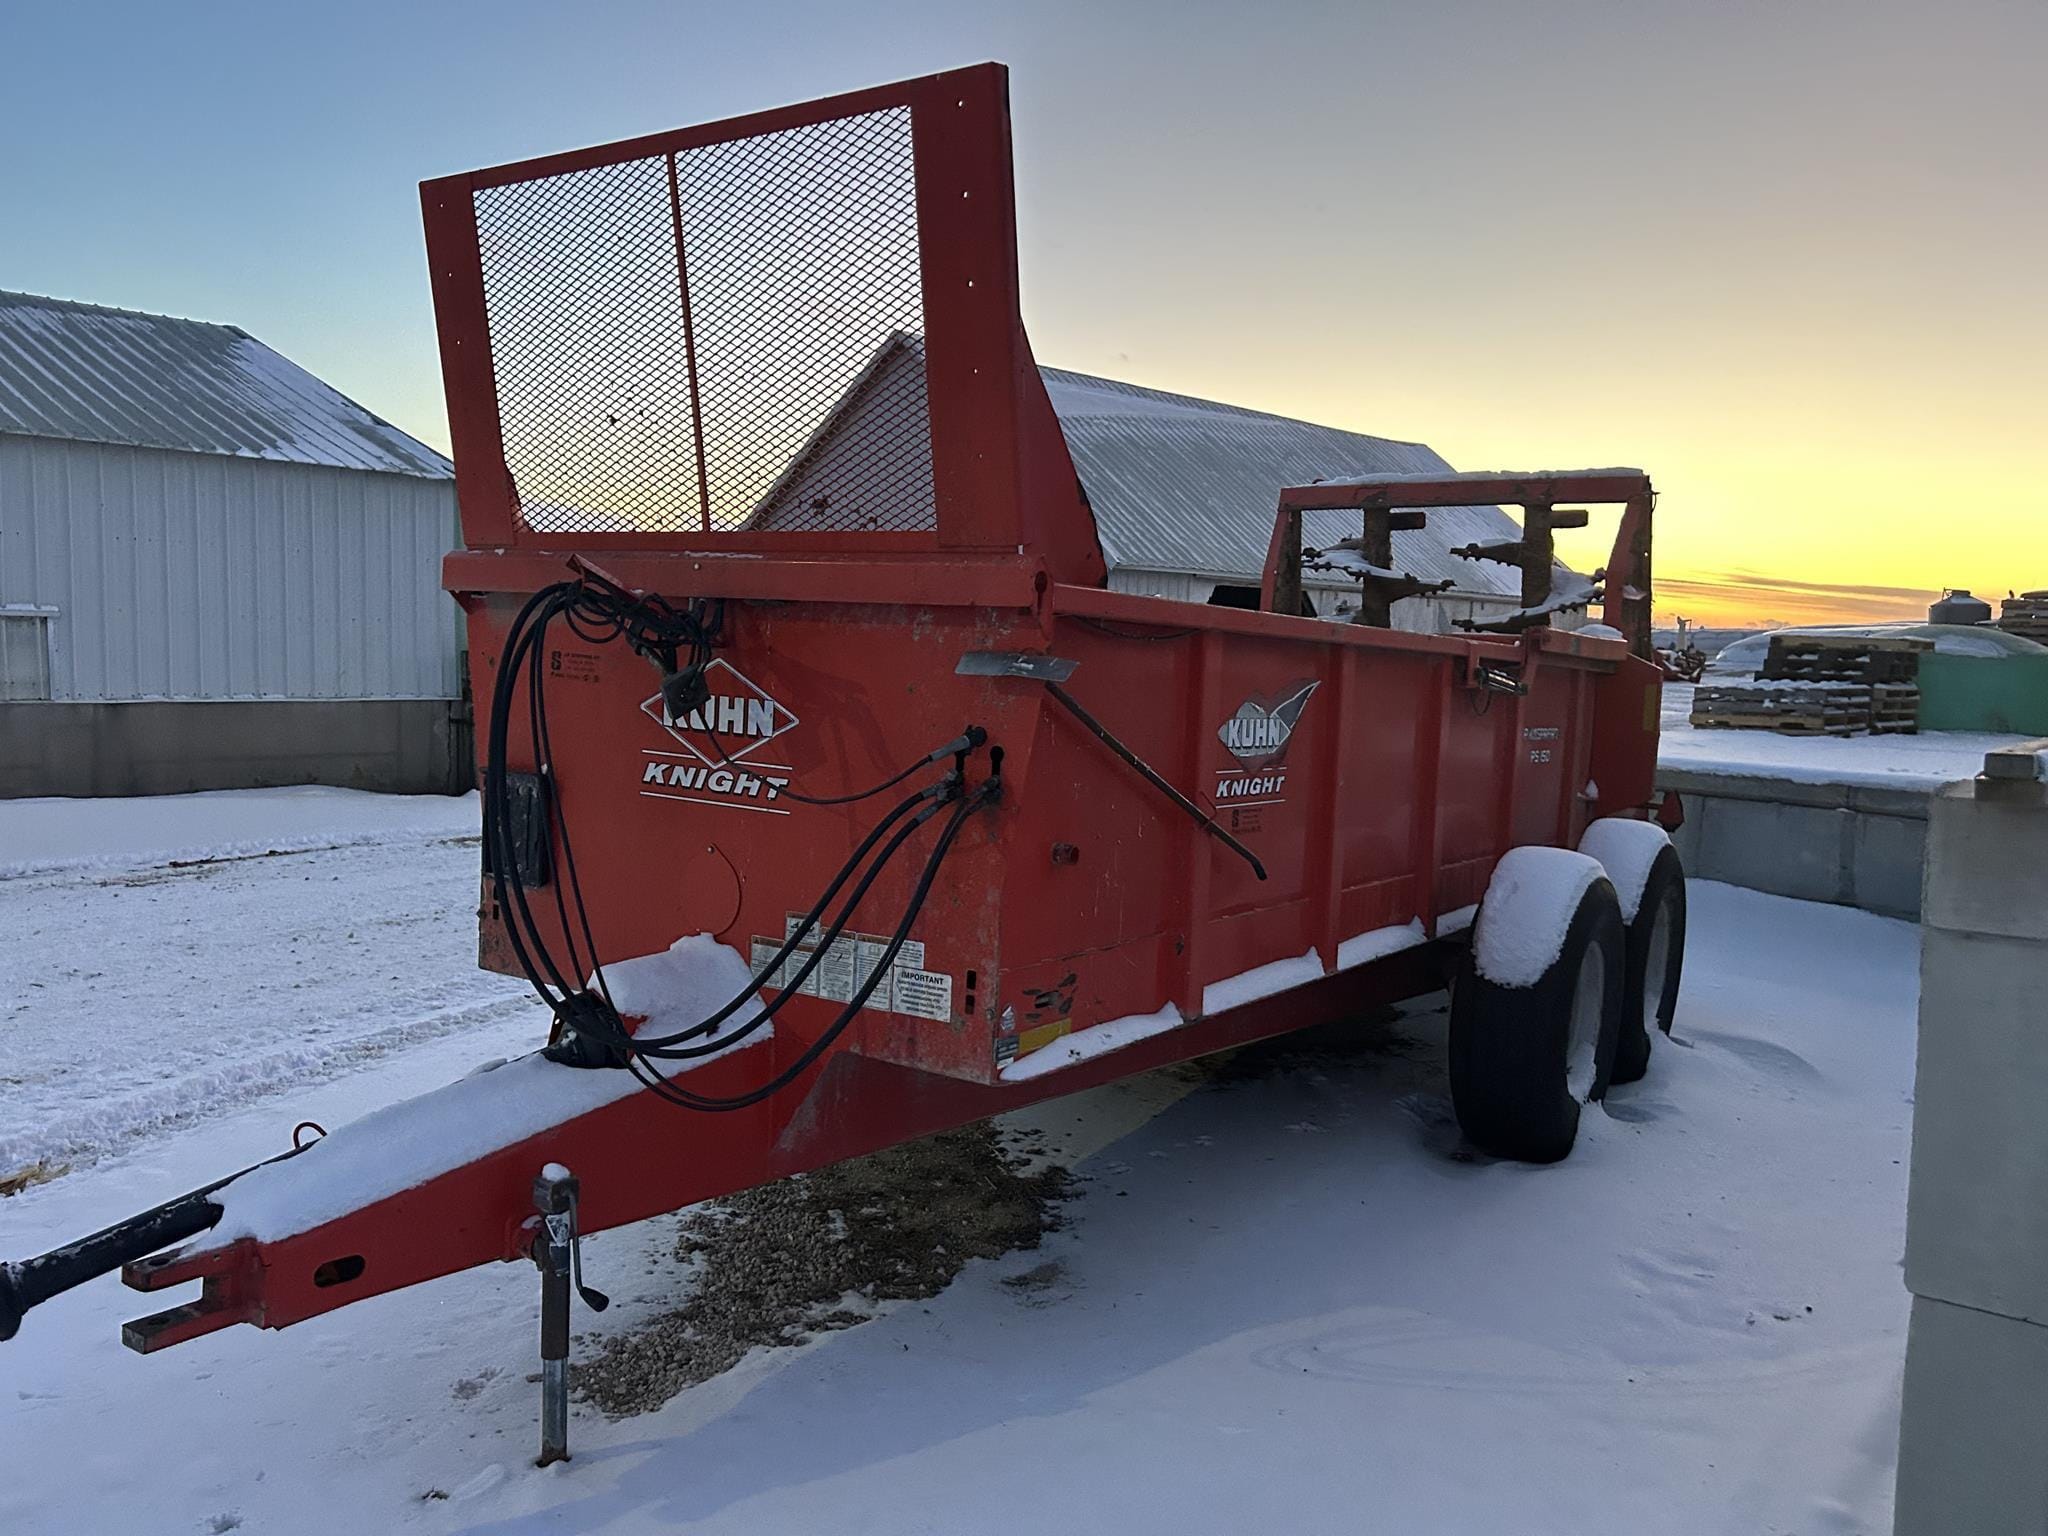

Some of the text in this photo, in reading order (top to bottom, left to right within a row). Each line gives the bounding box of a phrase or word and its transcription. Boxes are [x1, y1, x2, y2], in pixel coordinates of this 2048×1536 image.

[1227, 718, 1281, 749] KUHN
[642, 762, 789, 800] KNIGHT
[1215, 775, 1286, 799] KNIGHT
[901, 970, 945, 985] IMPORTANT
